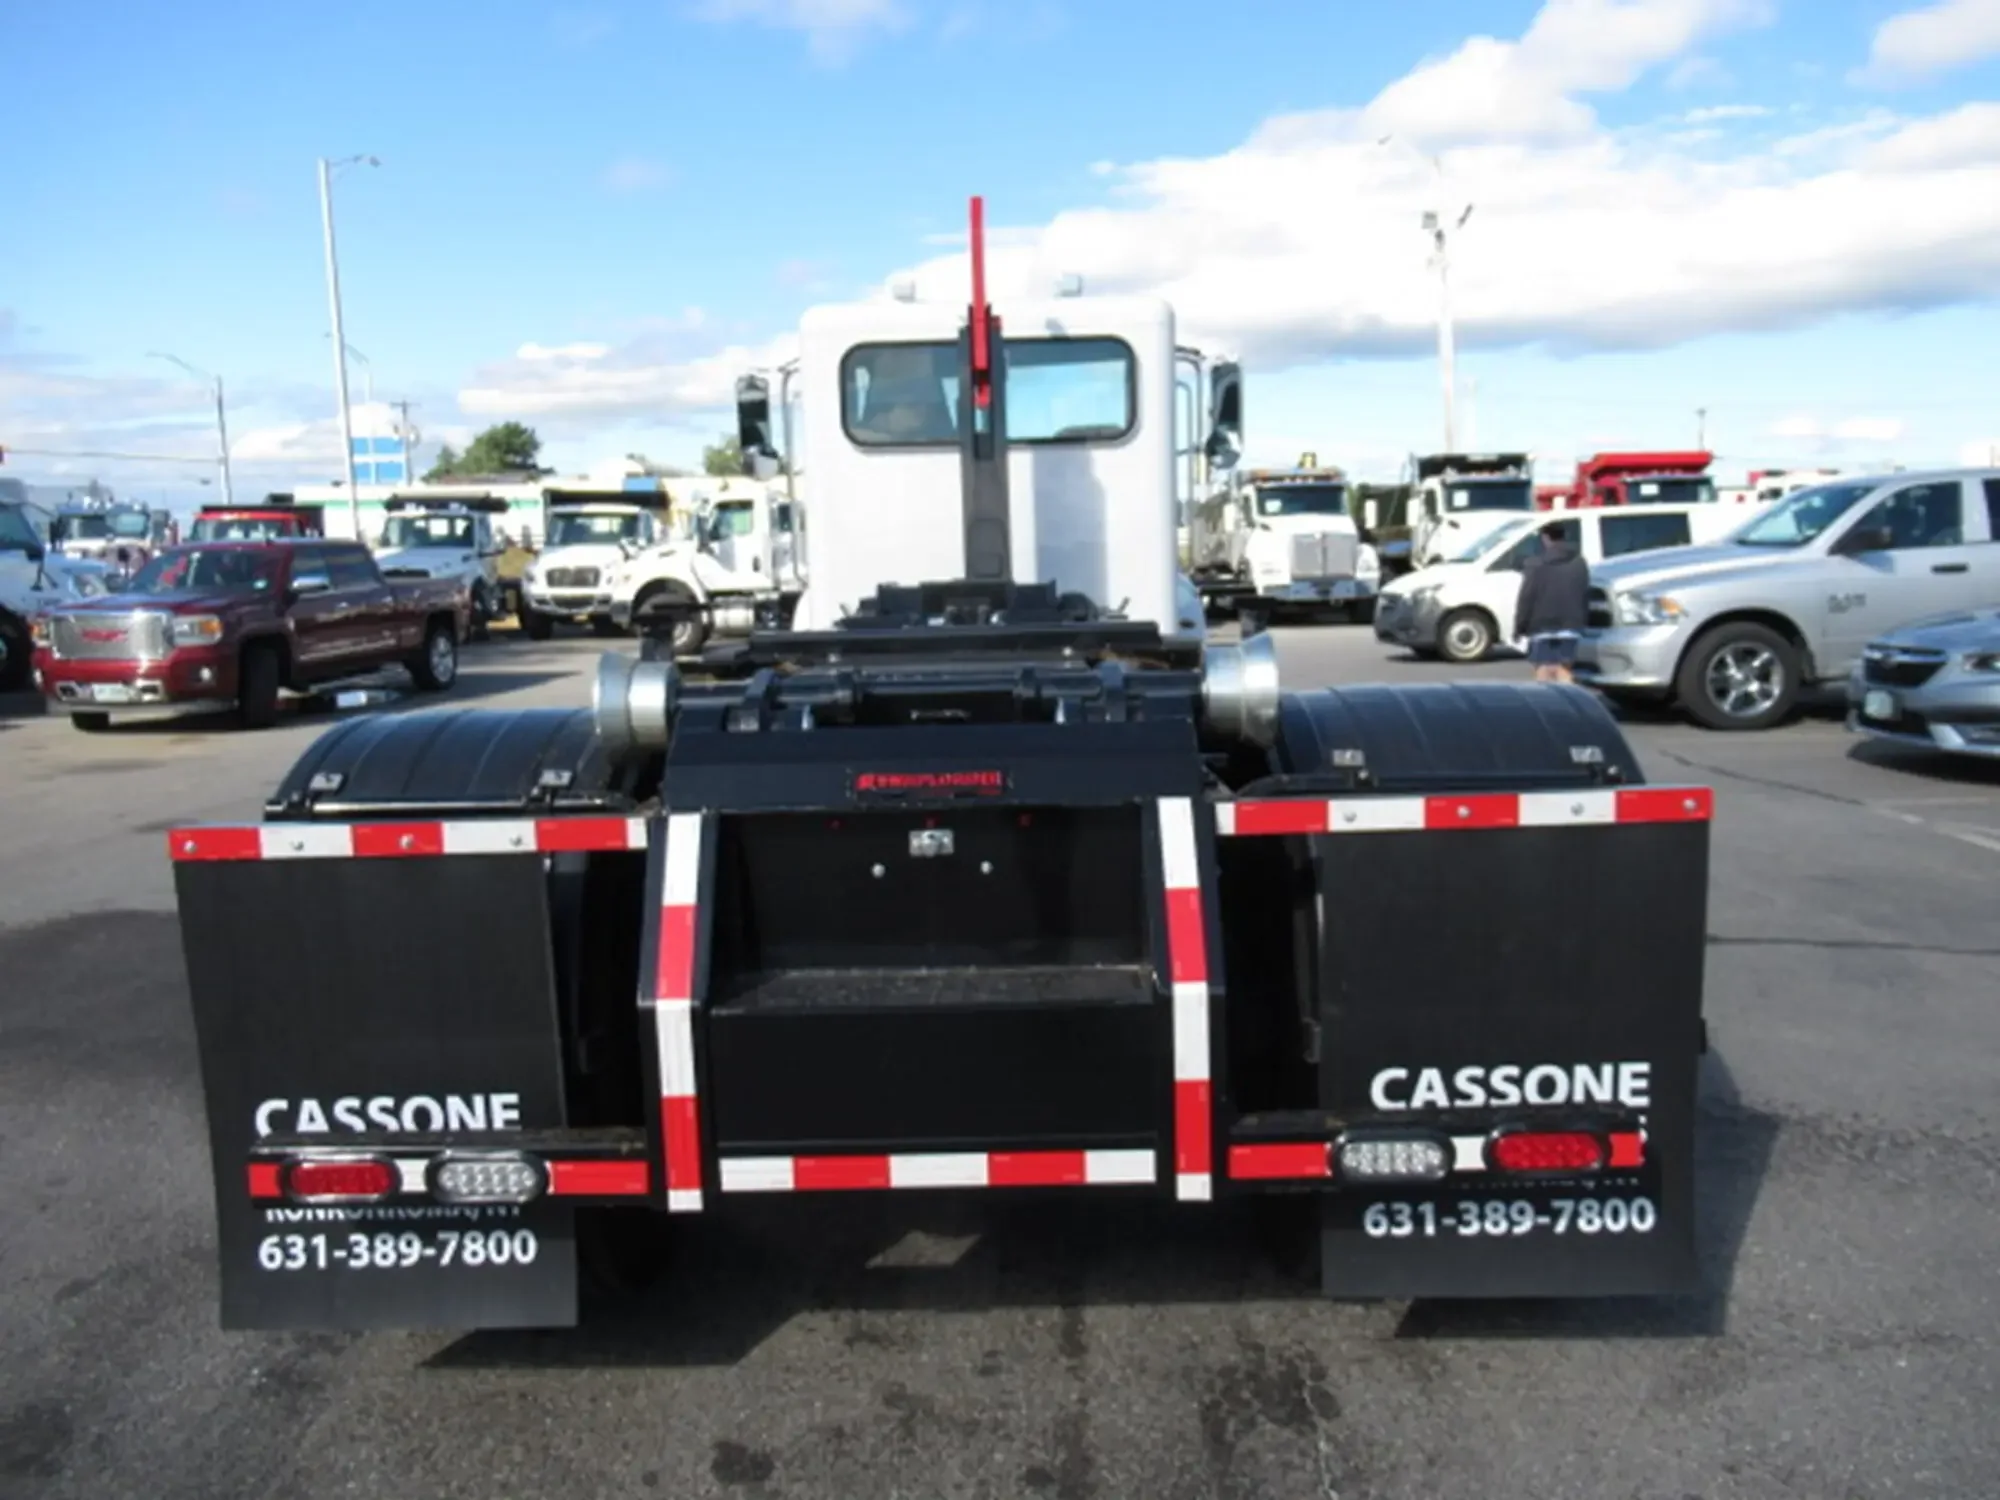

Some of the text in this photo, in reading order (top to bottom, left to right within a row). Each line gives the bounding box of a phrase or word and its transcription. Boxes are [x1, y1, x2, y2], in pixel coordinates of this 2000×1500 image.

[1370, 1062, 1651, 1110] CASSONE
[255, 1093, 521, 1138] CASSONE
[1363, 1197, 1655, 1237] 631-389-7800
[258, 1228, 537, 1270] 631-389-7800
